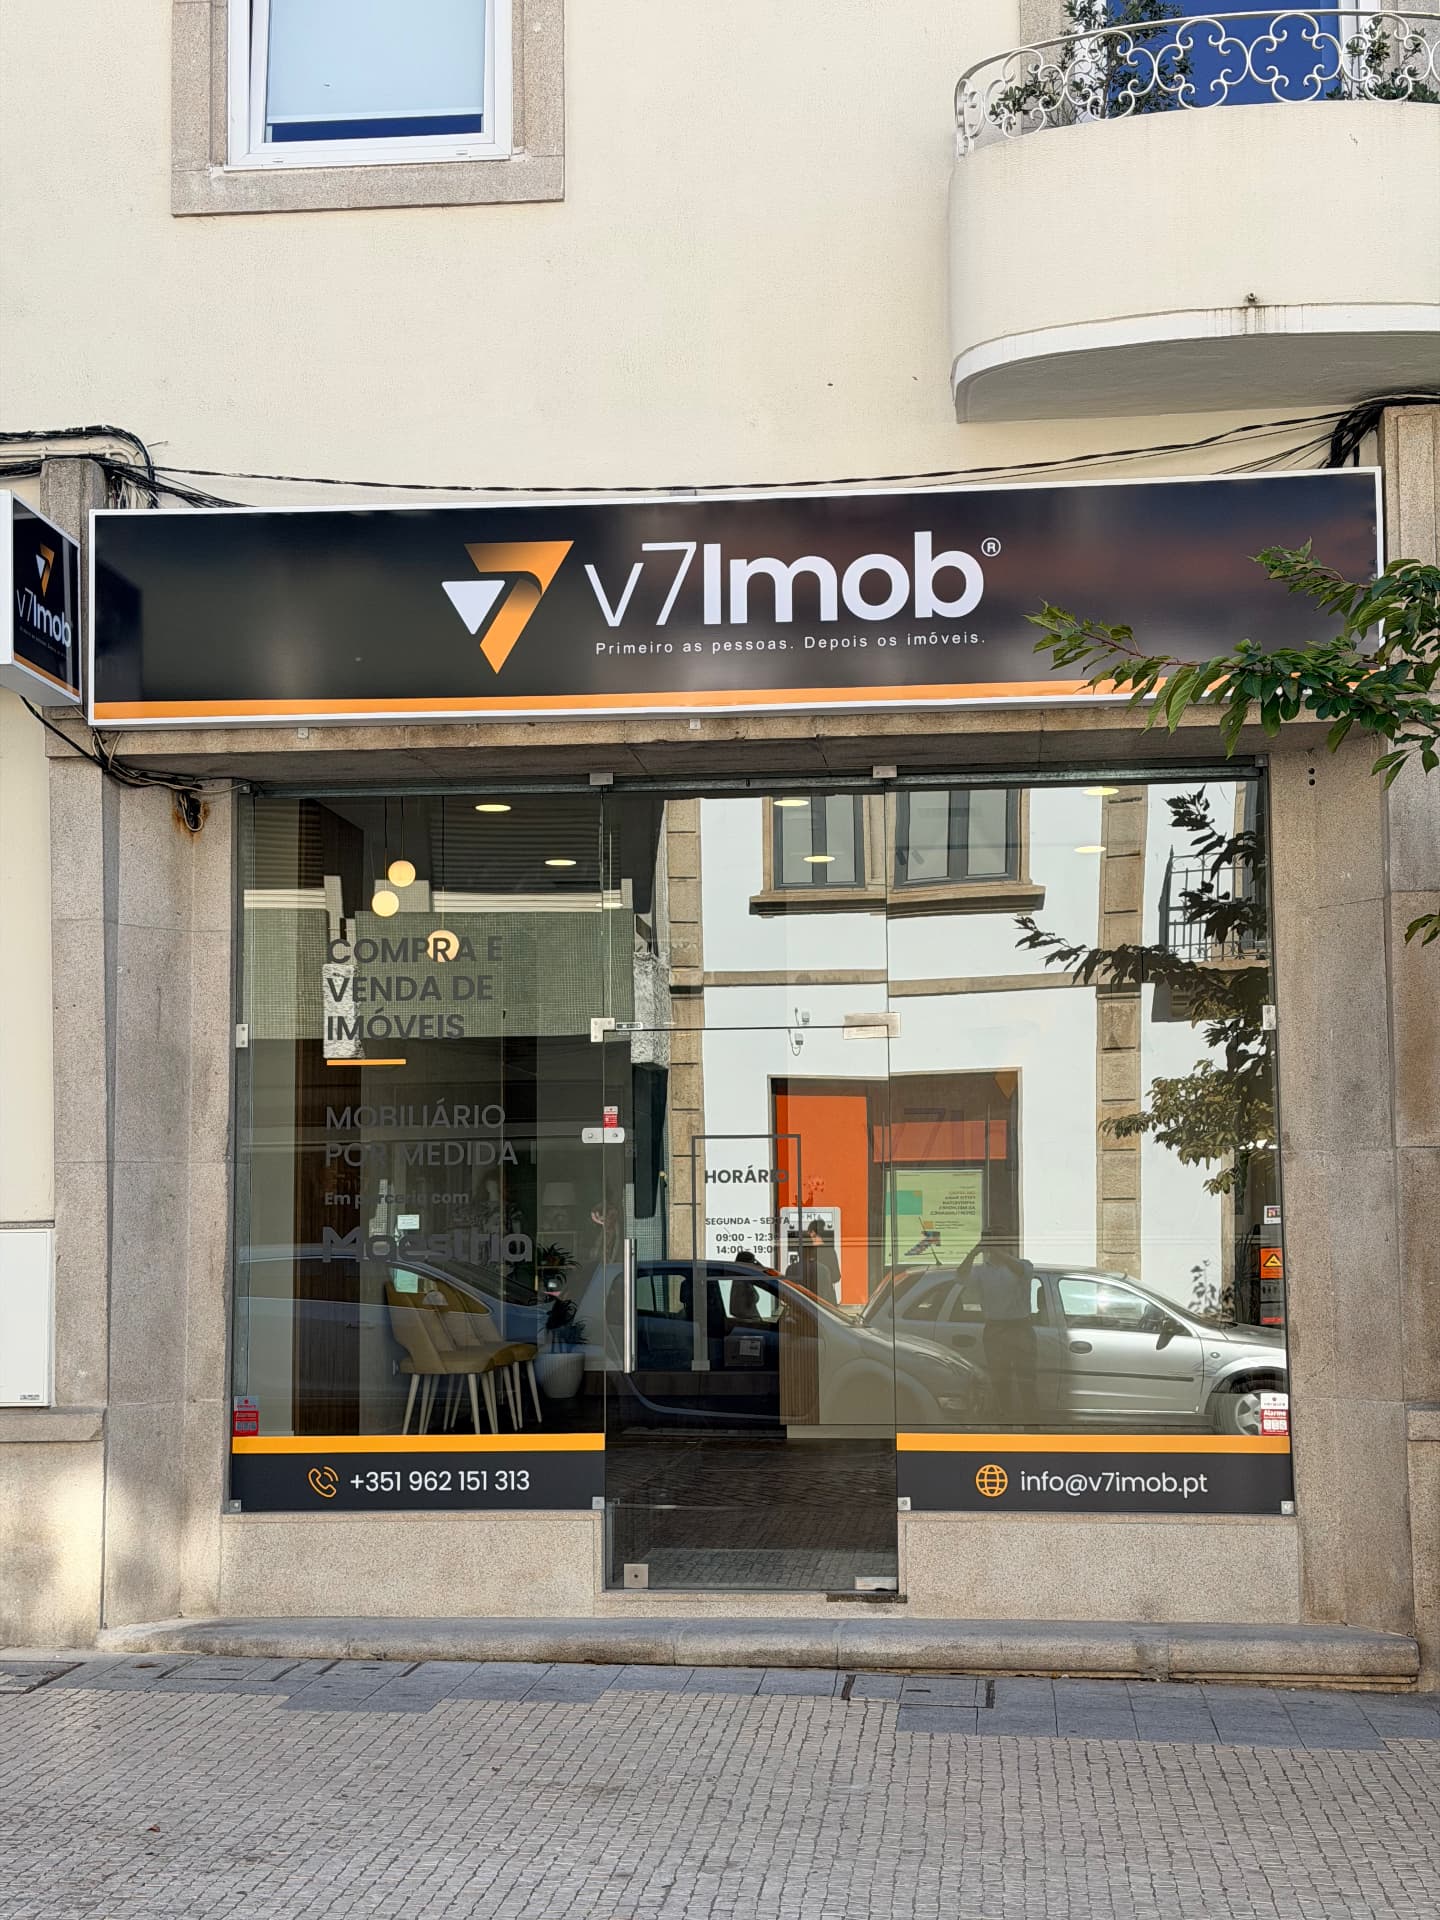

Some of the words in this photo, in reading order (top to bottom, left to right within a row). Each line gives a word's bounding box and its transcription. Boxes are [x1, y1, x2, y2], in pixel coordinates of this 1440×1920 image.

[584, 531, 984, 627] v7Imob
[596, 641, 673, 655] Primeiro
[682, 642, 702, 653] as
[712, 639, 794, 655] pessoas.
[804, 635, 868, 651] Depois
[877, 636, 897, 647] os
[907, 631, 985, 646] imóveis.
[327, 936, 478, 963] COMPRA
[487, 936, 503, 962] E
[326, 975, 442, 1002] VENDA
[452, 975, 493, 1001] DE
[327, 1007, 465, 1041] IMÓVEIS
[326, 1098, 506, 1130] MOBILIÁRIO
[325, 1142, 386, 1166] POR
[401, 1141, 519, 1166] MEDIDA
[704, 1165, 789, 1184] HORÁRIO
[324, 1192, 350, 1205] Em
[431, 1193, 469, 1205] com
[704, 1217, 751, 1226] SEGUNDA
[715, 1233, 745, 1242] 09:00
[350, 1471, 401, 1492] +351
[409, 1471, 452, 1492] 962
[458, 1470, 487, 1491] 151
[495, 1470, 530, 1491] 313
[1020, 1470, 1208, 1498] info@v7imob.pt
